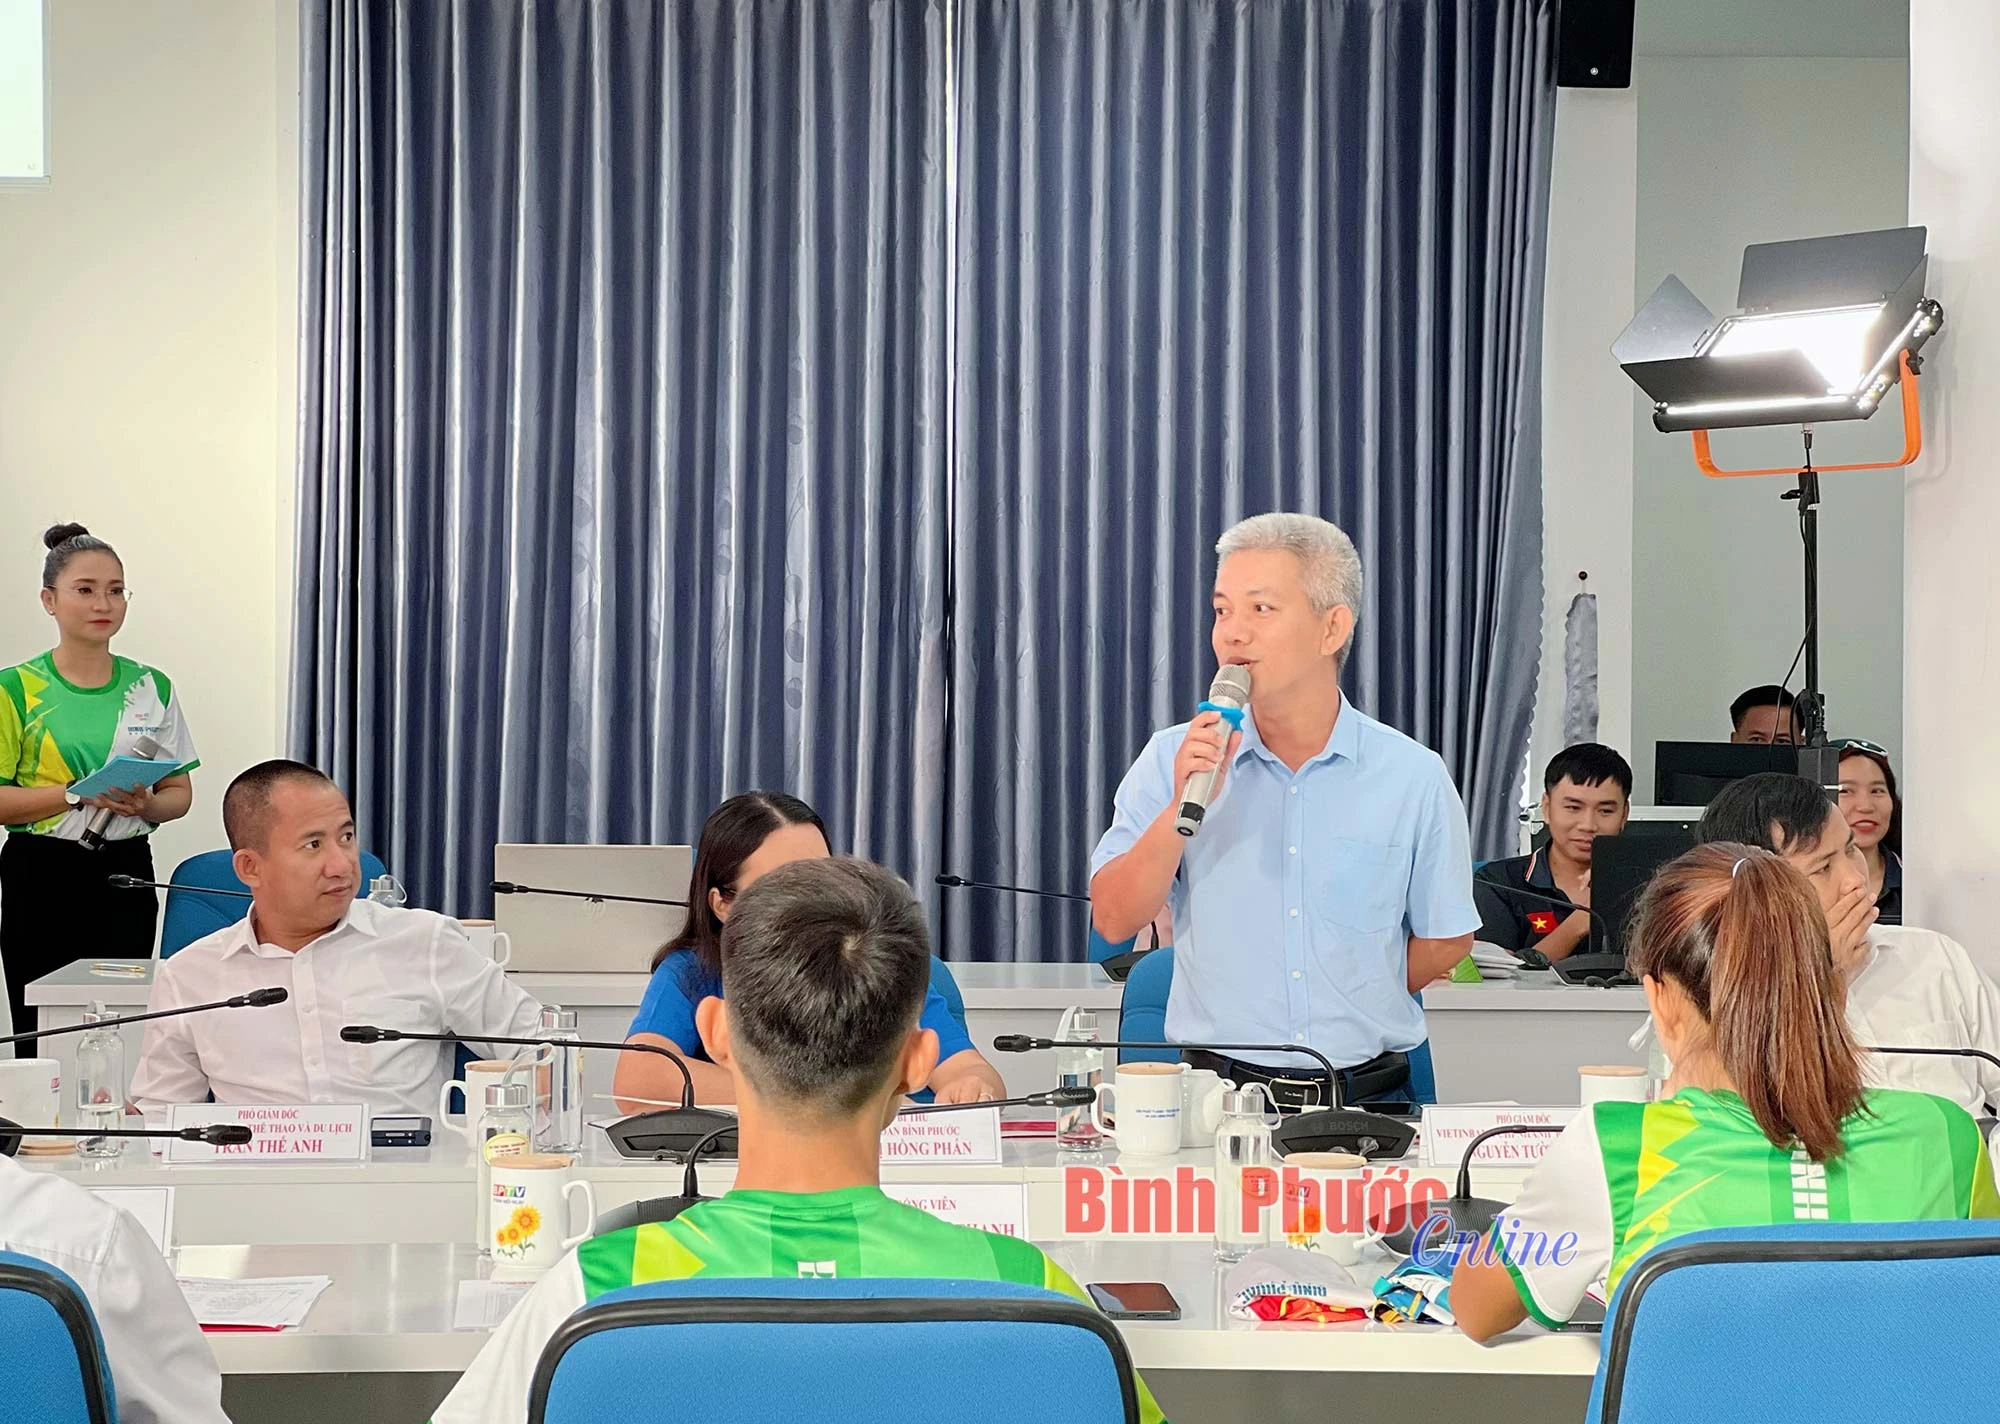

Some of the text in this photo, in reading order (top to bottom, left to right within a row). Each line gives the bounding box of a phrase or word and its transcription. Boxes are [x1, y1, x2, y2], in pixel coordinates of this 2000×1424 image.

[268, 1124, 297, 1133] THAO
[298, 1121, 311, 1133] VÀ
[313, 1124, 327, 1133] DU
[329, 1123, 352, 1136] LỊCH
[1329, 1121, 1369, 1132] BOSCH
[290, 1139, 322, 1153] ANH
[1472, 1141, 1522, 1159] GUYỄN
